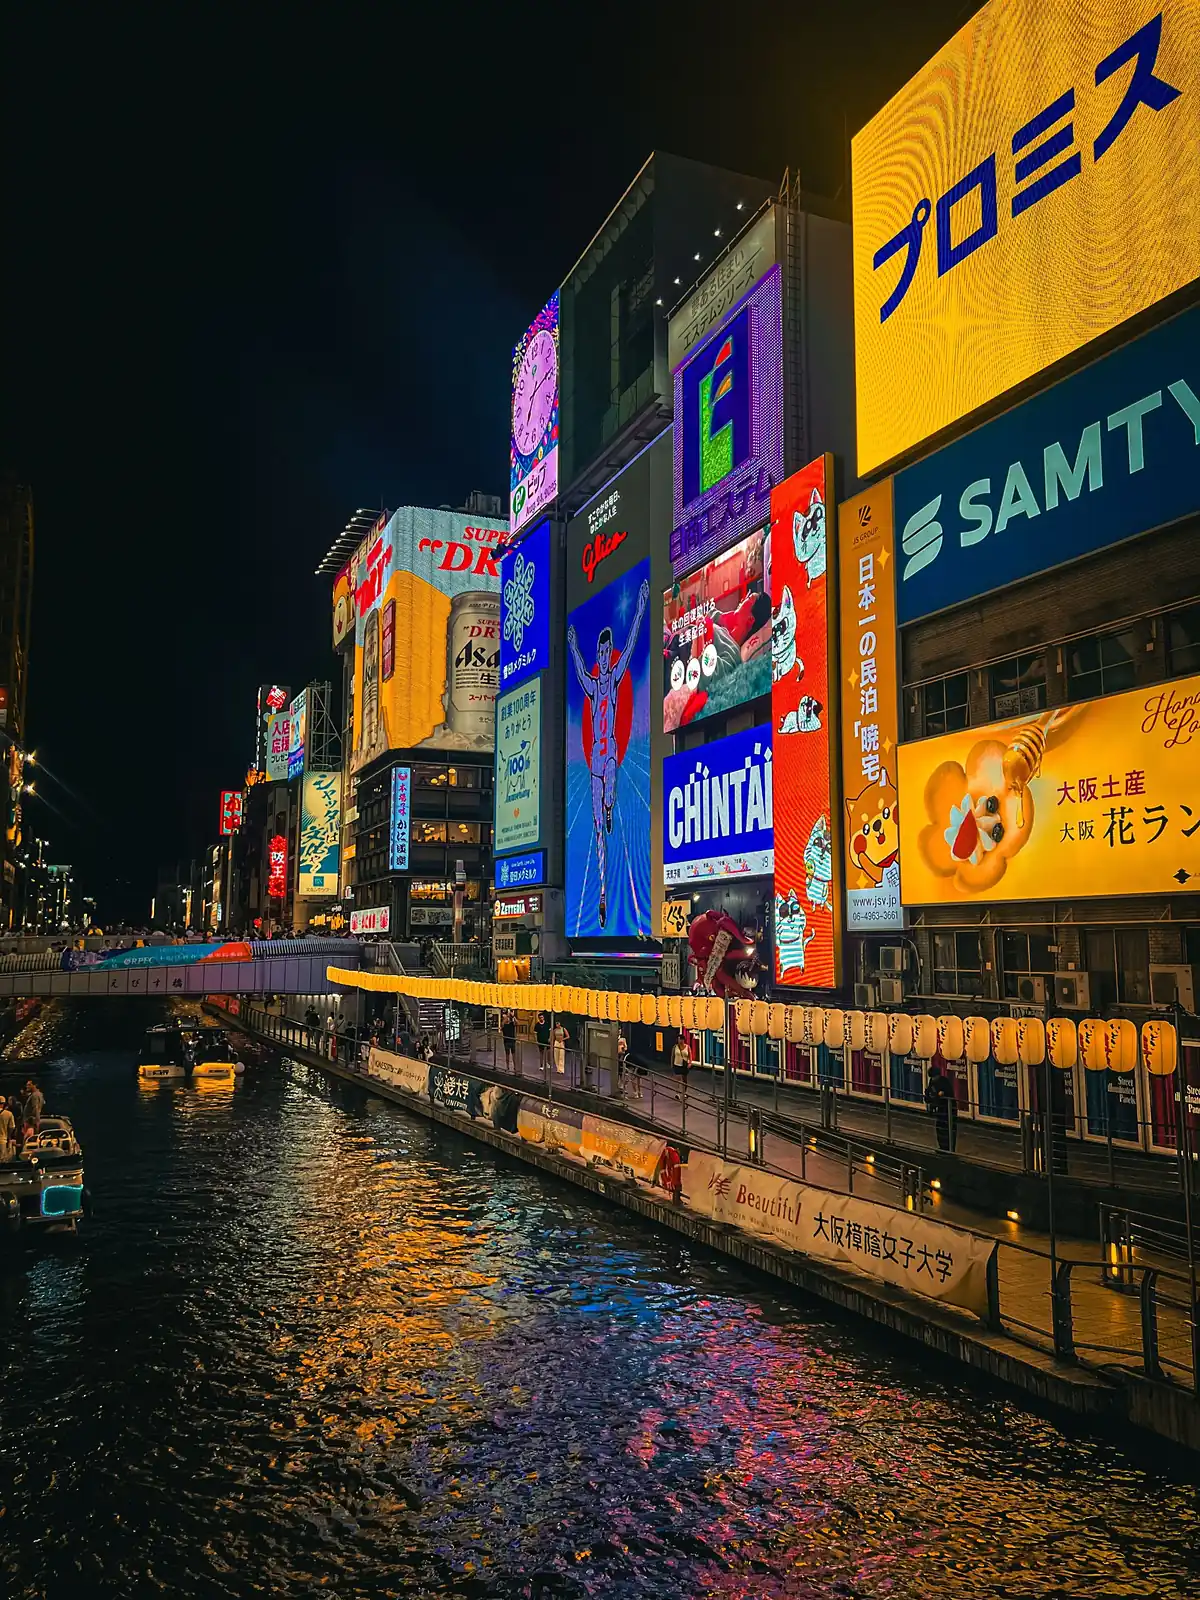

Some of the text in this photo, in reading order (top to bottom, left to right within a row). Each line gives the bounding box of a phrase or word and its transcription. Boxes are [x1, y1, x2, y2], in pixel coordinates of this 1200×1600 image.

[873, 11, 1183, 324] プロミス
[527, 461, 547, 499] ピップ
[860, 527, 879, 541] GROUP
[418, 537, 501, 578] “DR
[581, 531, 627, 584] Glico
[503, 648, 537, 680] 雪印メグミルク
[501, 689, 536, 721] 創業100周年
[504, 714, 532, 740] ありがとう
[598, 698, 609, 757] グリコ
[1057, 770, 1145, 806] 大阪土産
[1059, 819, 1094, 843] 大阪
[852, 894, 898, 908] www.jsv.jp
[852, 910, 899, 921] 06-4963-3661
[111, 977, 183, 989] えびす橋
[736, 1184, 802, 1225] Beautiful
[813, 1211, 954, 1284] 大阪樟蔭女子大学
